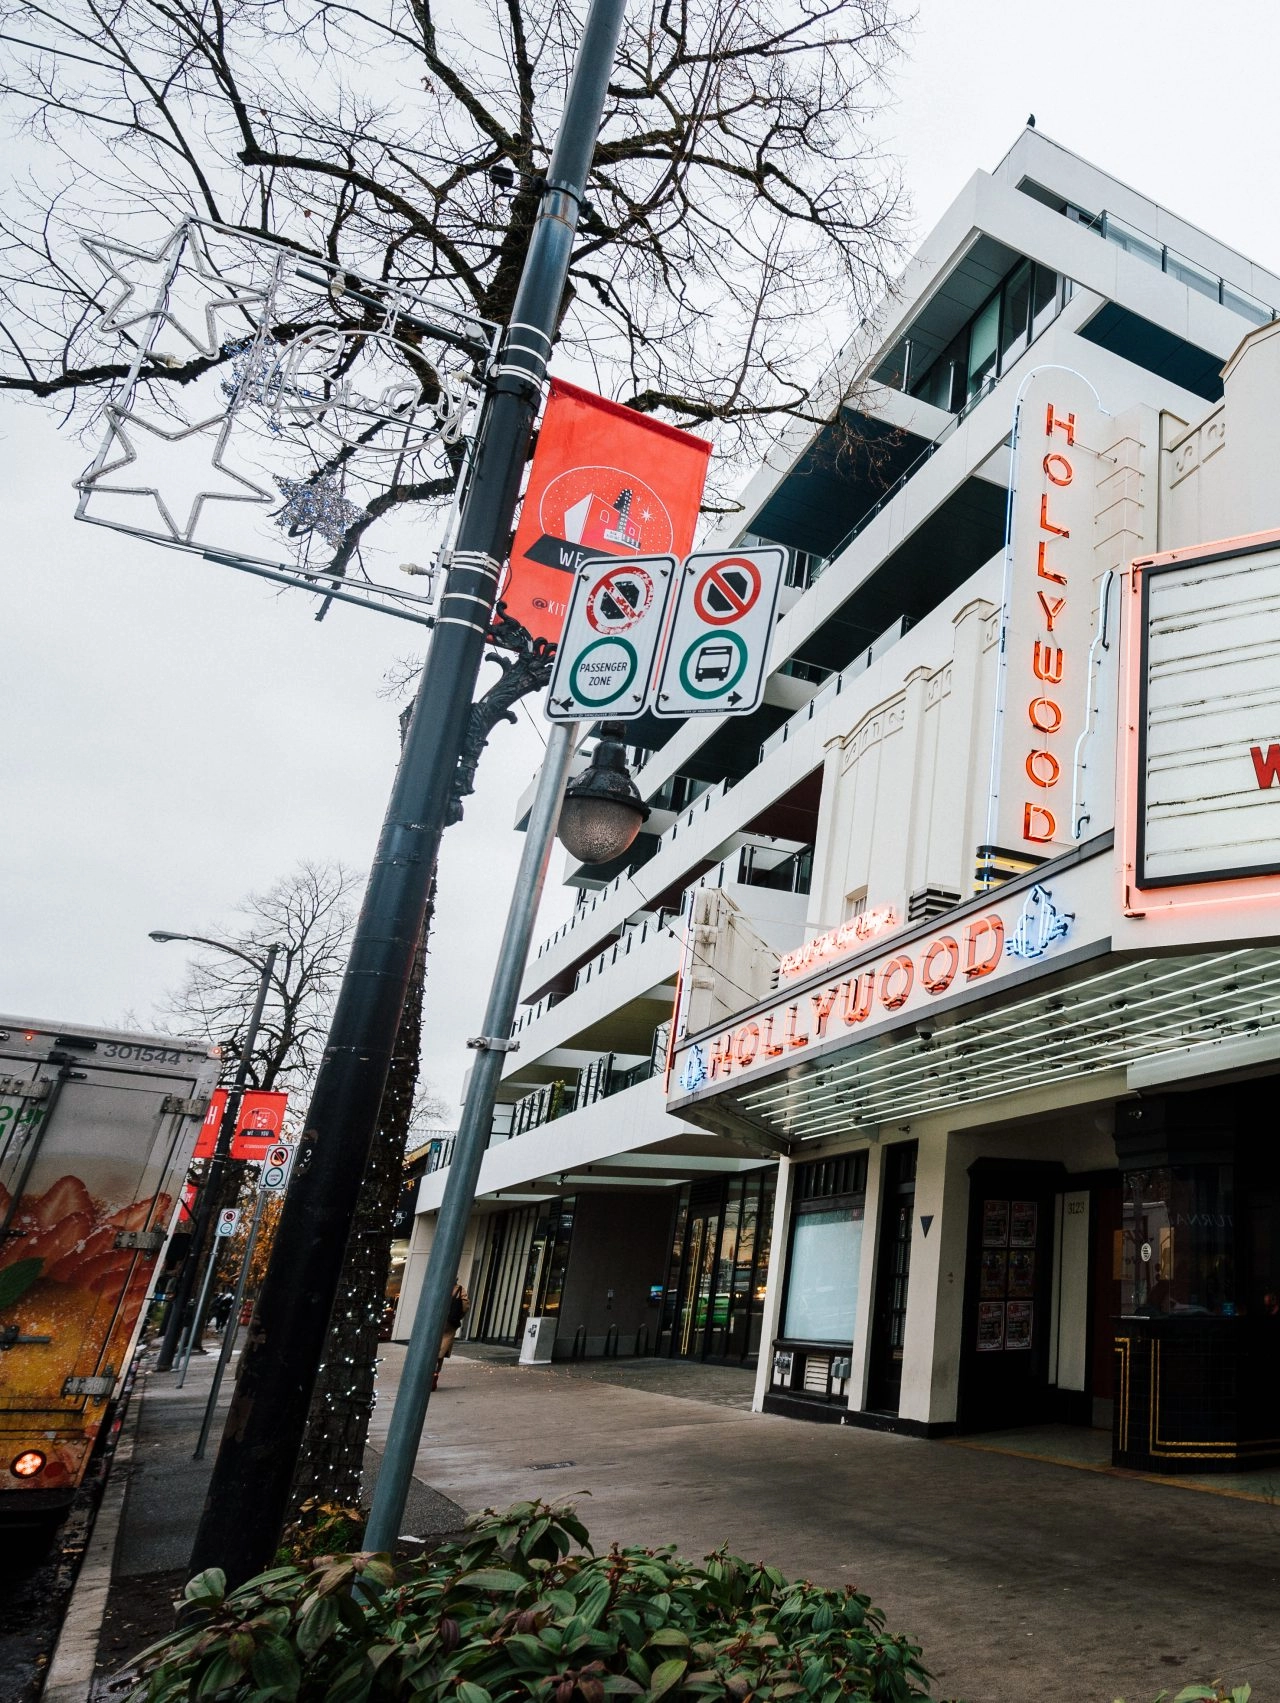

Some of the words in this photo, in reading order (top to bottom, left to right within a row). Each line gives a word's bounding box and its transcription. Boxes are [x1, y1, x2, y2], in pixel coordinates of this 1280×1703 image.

[559, 547, 585, 569] WE
[532, 597, 567, 617] @KIT
[1022, 402, 1076, 843] HOLLYWOOD
[580, 661, 628, 673] PASSENGER
[588, 676, 612, 686] ZONE
[708, 913, 1005, 1081] HOLLYWOOD
[103, 1044, 181, 1066] 301544
[1068, 1201, 1085, 1214] 3123
